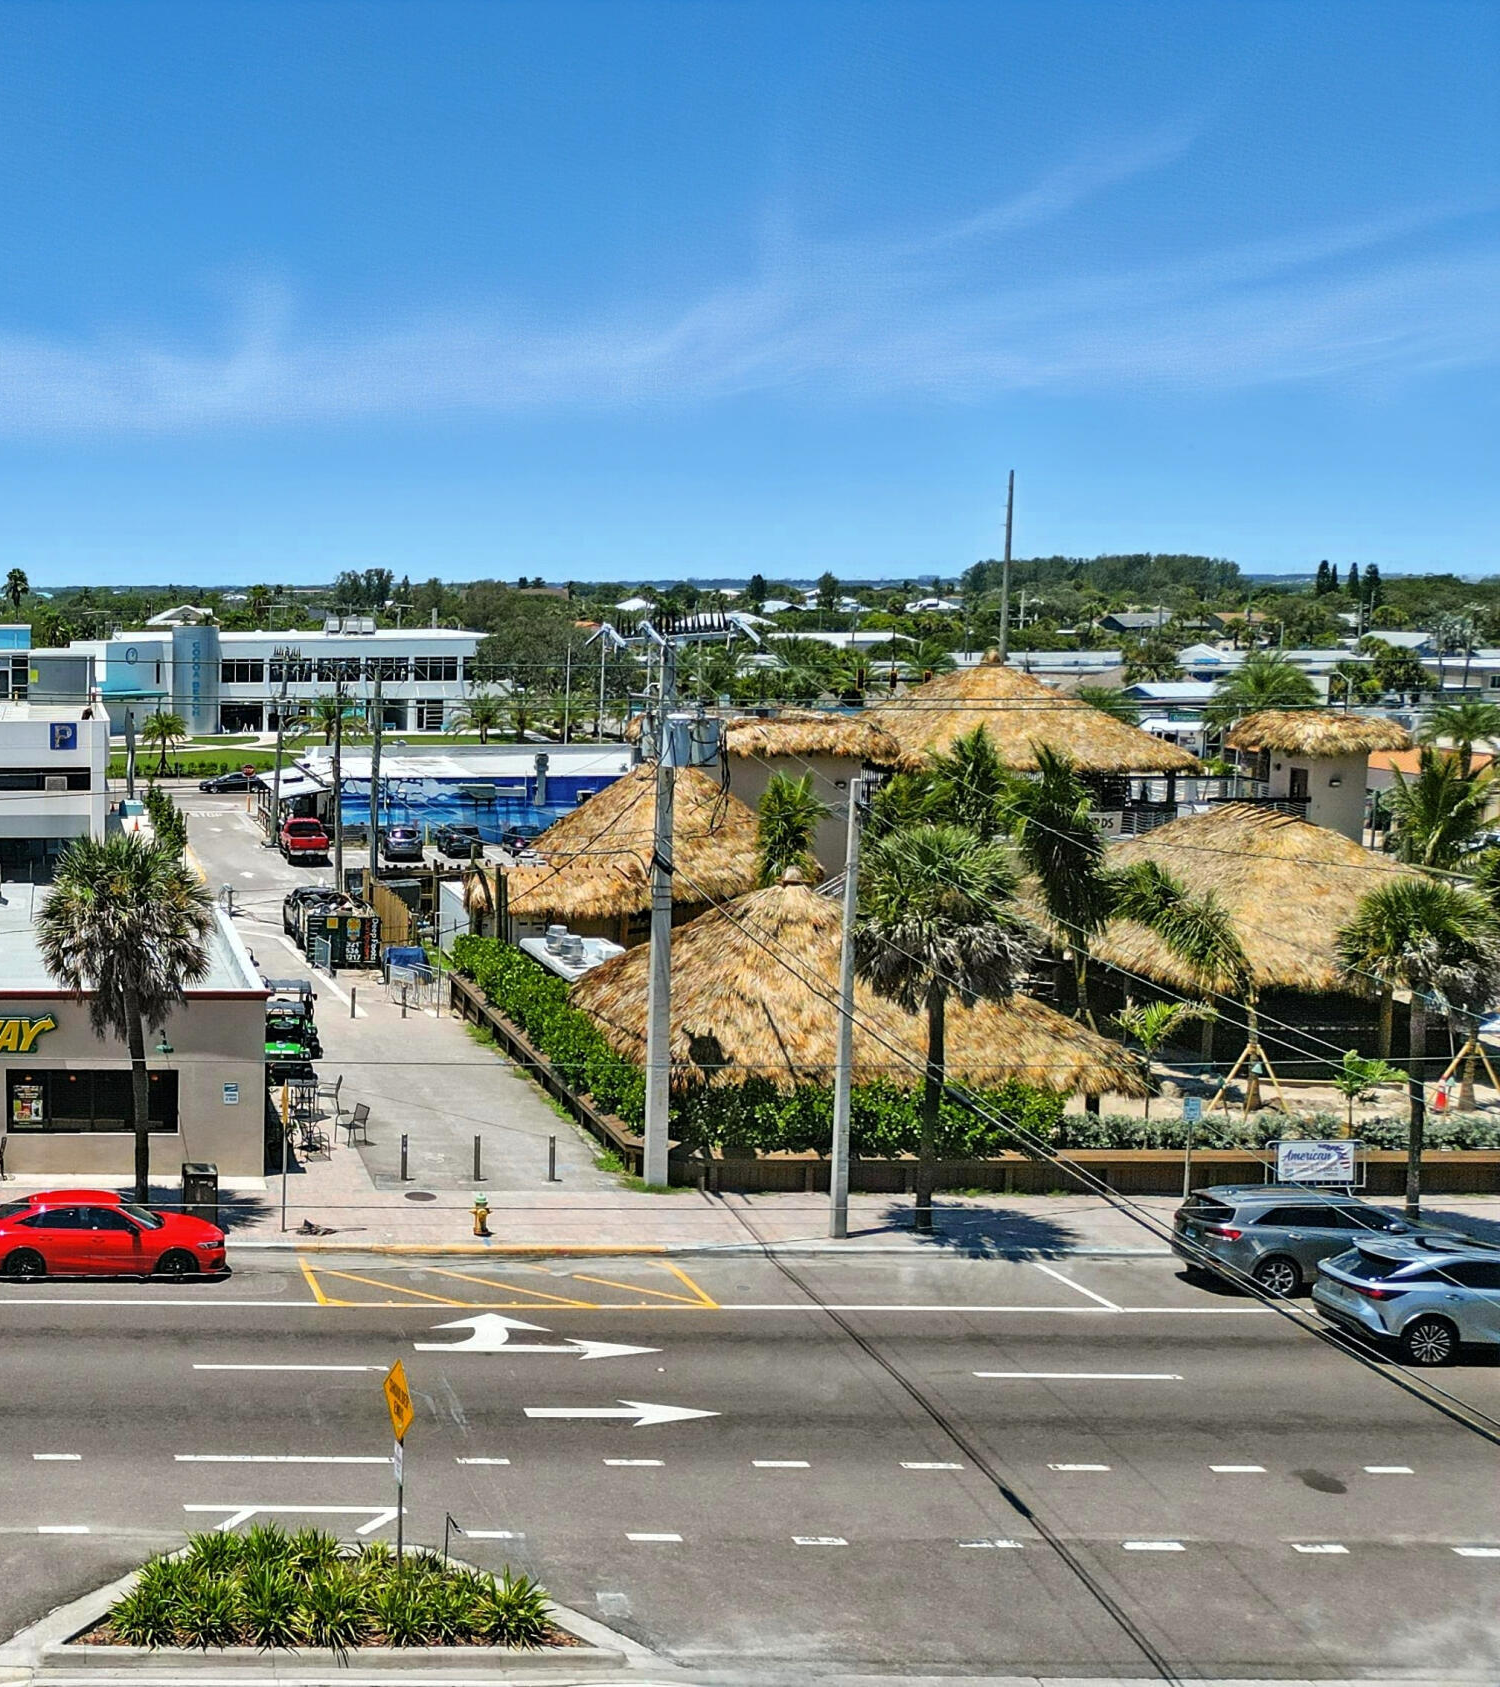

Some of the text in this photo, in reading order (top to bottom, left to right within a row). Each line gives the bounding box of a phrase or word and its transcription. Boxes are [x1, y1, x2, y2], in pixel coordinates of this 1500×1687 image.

[192, 641, 201, 678] COCOA
[54, 725, 73, 748] P
[369, 918, 379, 938] Deep
[1282, 1149, 1332, 1161] American
